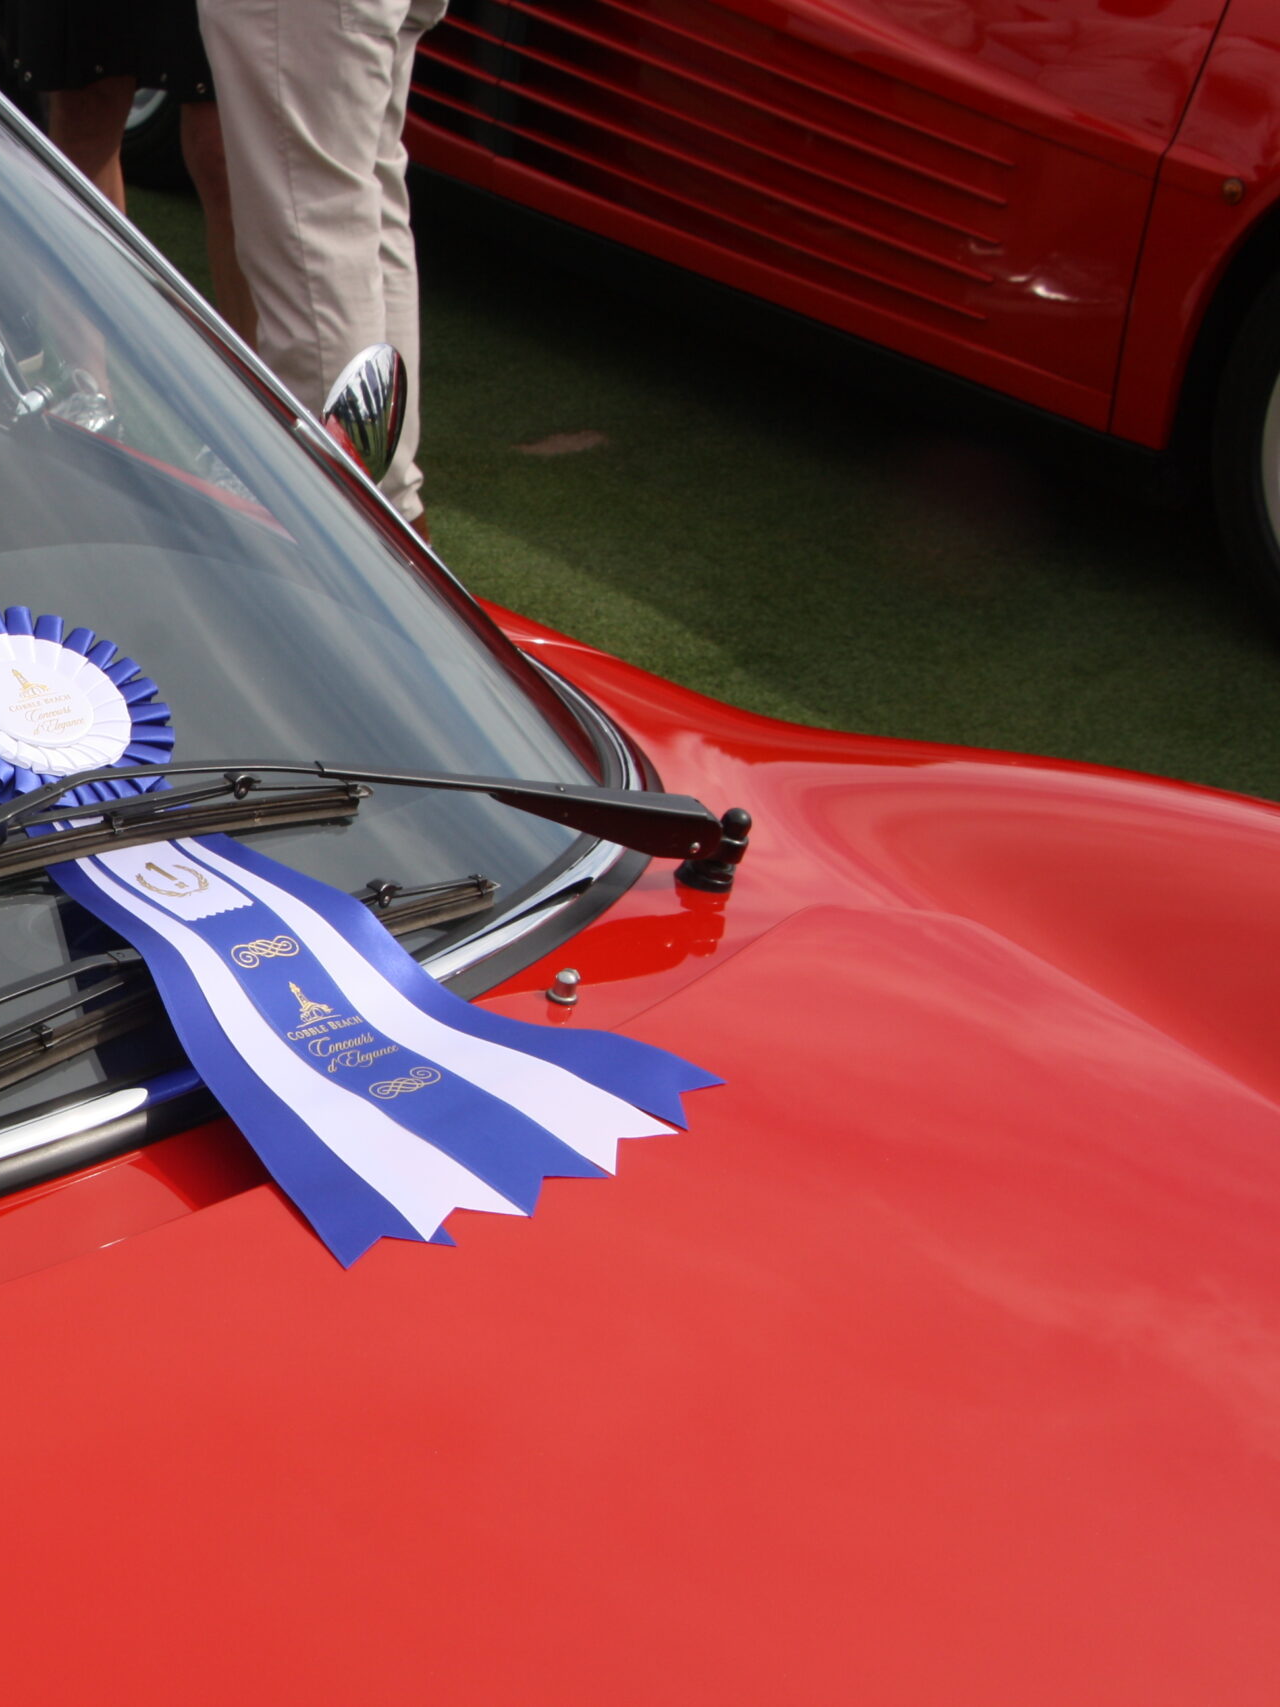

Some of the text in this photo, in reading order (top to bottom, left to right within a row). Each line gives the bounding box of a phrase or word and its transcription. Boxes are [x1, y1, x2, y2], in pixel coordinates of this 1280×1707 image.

[287, 1015, 365, 1041] COBBLE BEACH
[308, 1032, 375, 1057] Concours
